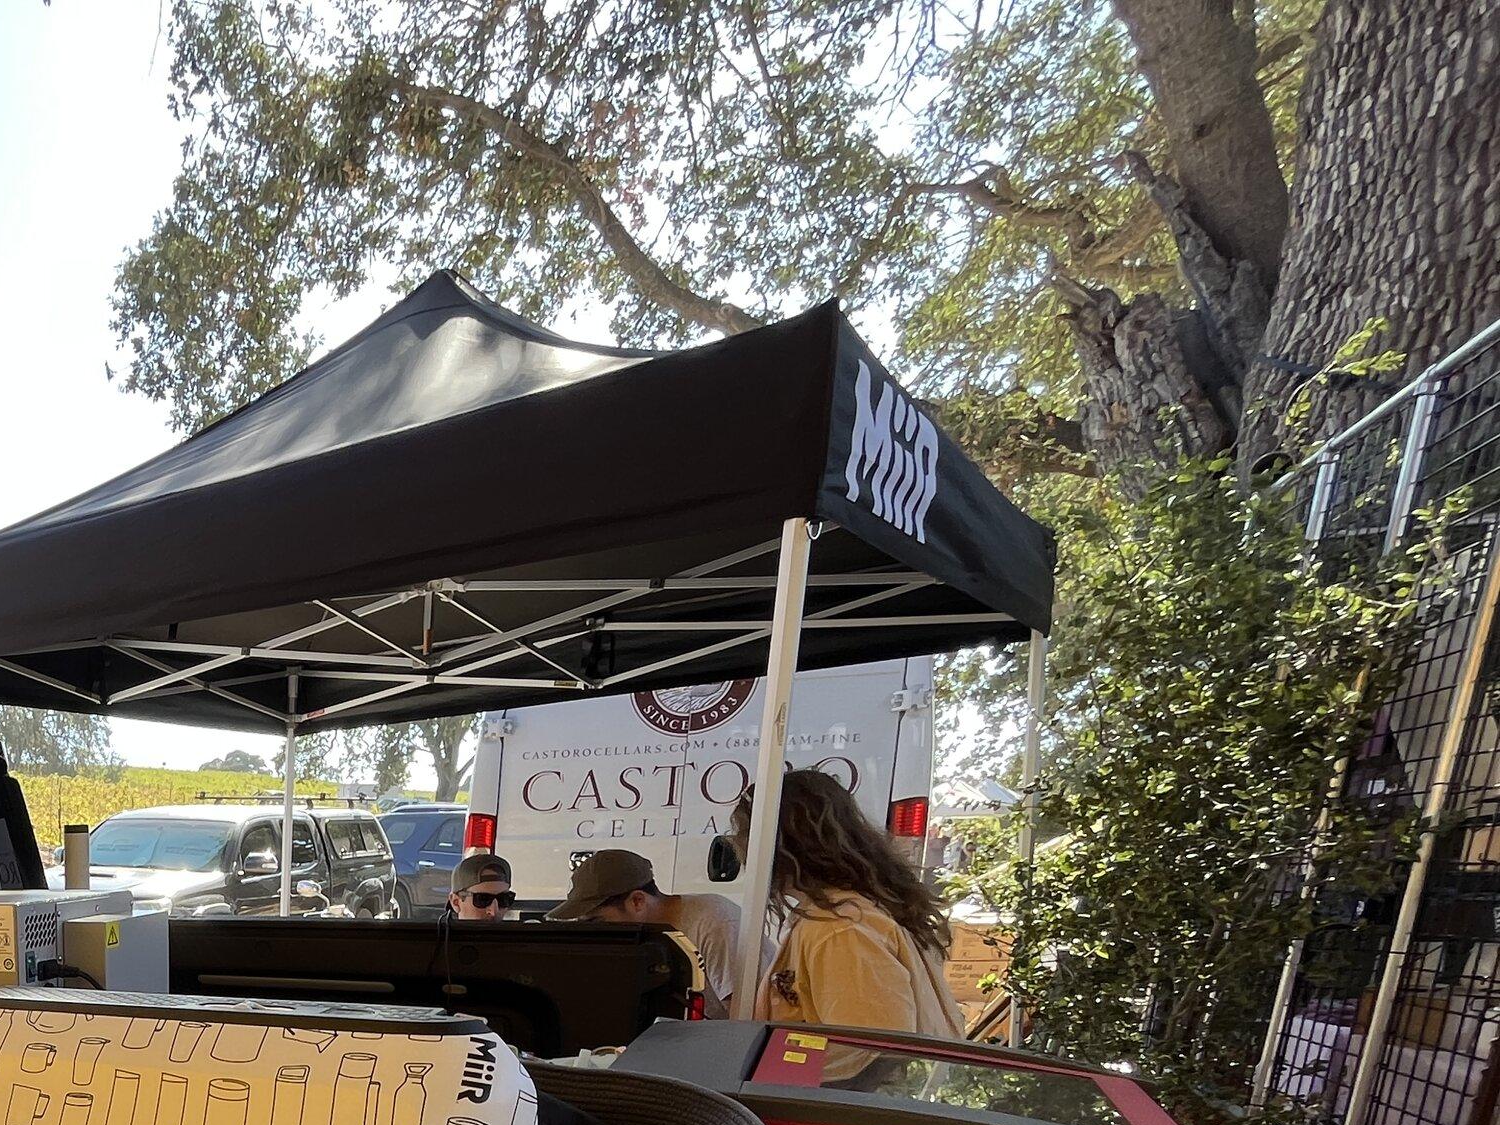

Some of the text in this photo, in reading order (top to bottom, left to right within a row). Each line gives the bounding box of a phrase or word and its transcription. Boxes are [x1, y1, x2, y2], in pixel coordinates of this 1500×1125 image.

[845, 358, 939, 545] MiiR
[643, 696, 738, 731] SINCE 1983
[522, 739, 706, 761] CASTOROCELLARS.COM
[788, 732, 862, 747] AM-FINE
[521, 756, 862, 813] CASTOO
[575, 815, 722, 840] CELLA
[456, 1036, 497, 1104] MiiR
